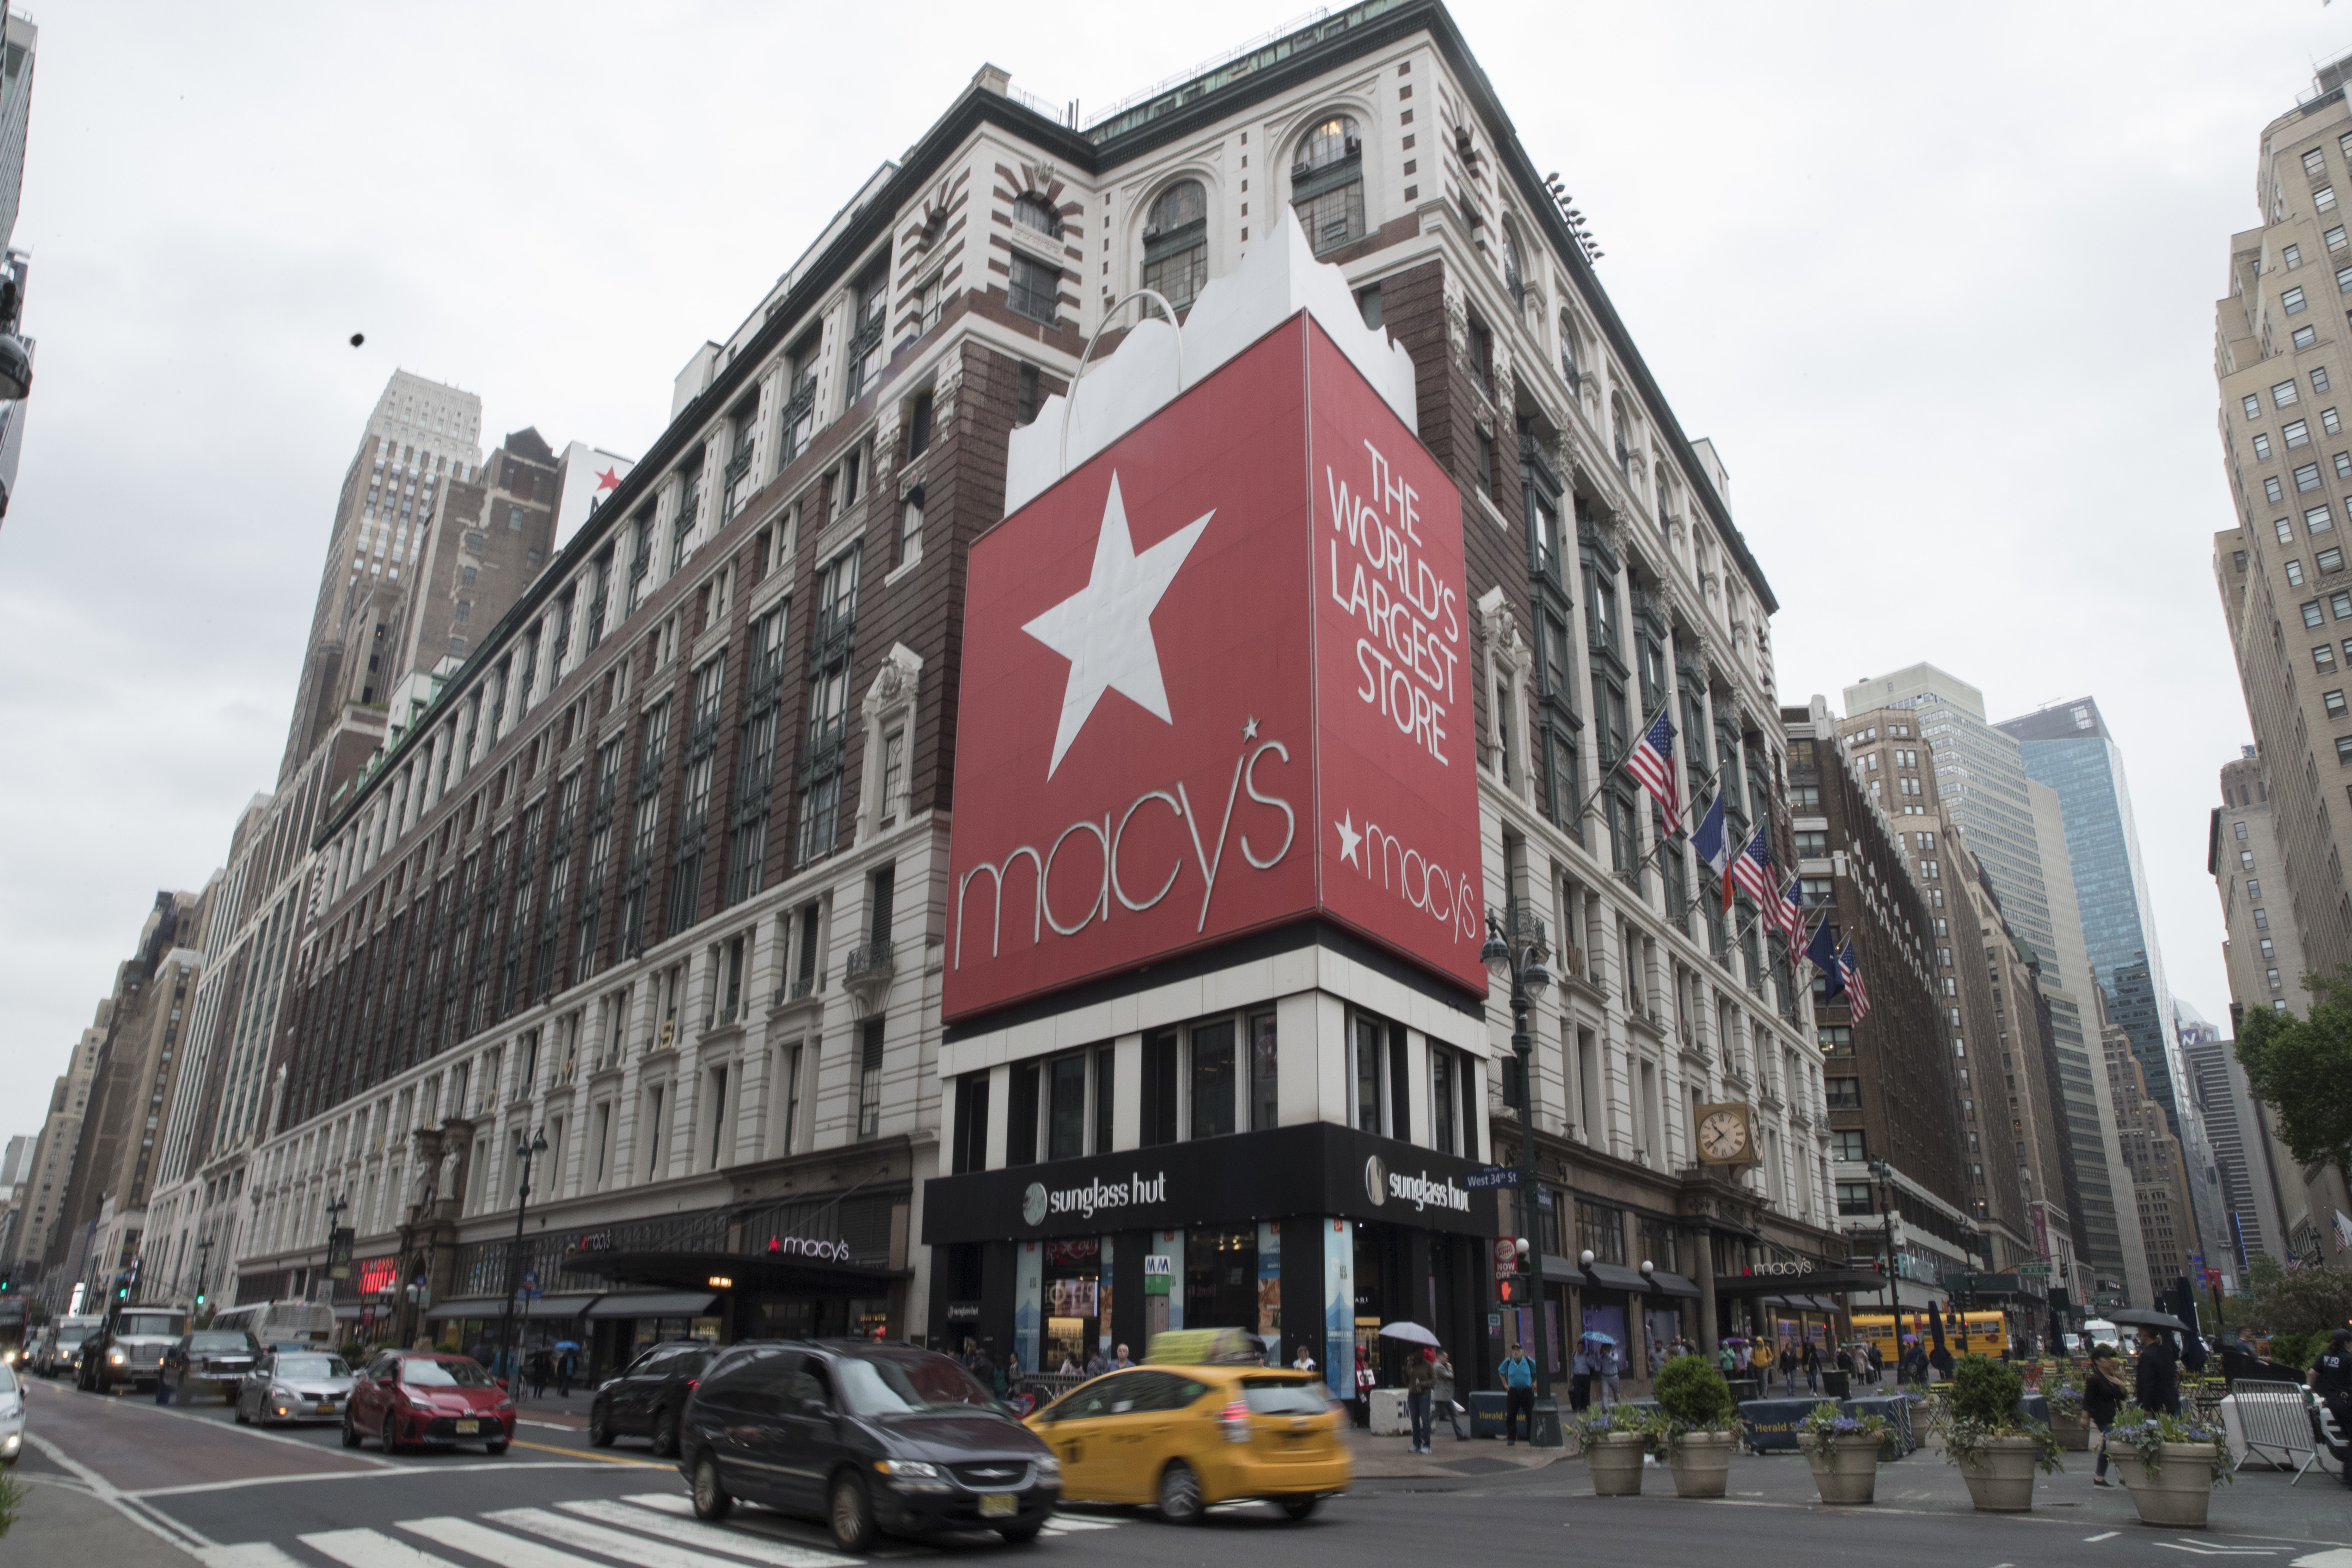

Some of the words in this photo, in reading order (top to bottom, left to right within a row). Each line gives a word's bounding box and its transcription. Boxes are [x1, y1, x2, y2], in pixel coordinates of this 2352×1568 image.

[1364, 438, 1422, 548] THE
[1326, 464, 1459, 643] WORLD'S
[1331, 539, 1458, 704] LARGEST
[1357, 638, 1449, 766] STORE
[954, 714, 1295, 971] macy's
[1366, 821, 1476, 944] macy's
[1050, 1176, 1129, 1219] sunglass
[1132, 1171, 1167, 1205] hut
[1389, 1170, 1448, 1212] sunglass
[1467, 1175, 1488, 1187] West
[1490, 1172, 1506, 1185] 34th
[1508, 1171, 1517, 1183] St
[784, 1235, 849, 1263] macy's
[1497, 1262, 1515, 1271] NOW
[1754, 1257, 1812, 1278] macy's
[1479, 1411, 1504, 1421] Herald
[1755, 1421, 1788, 1433] Herald
